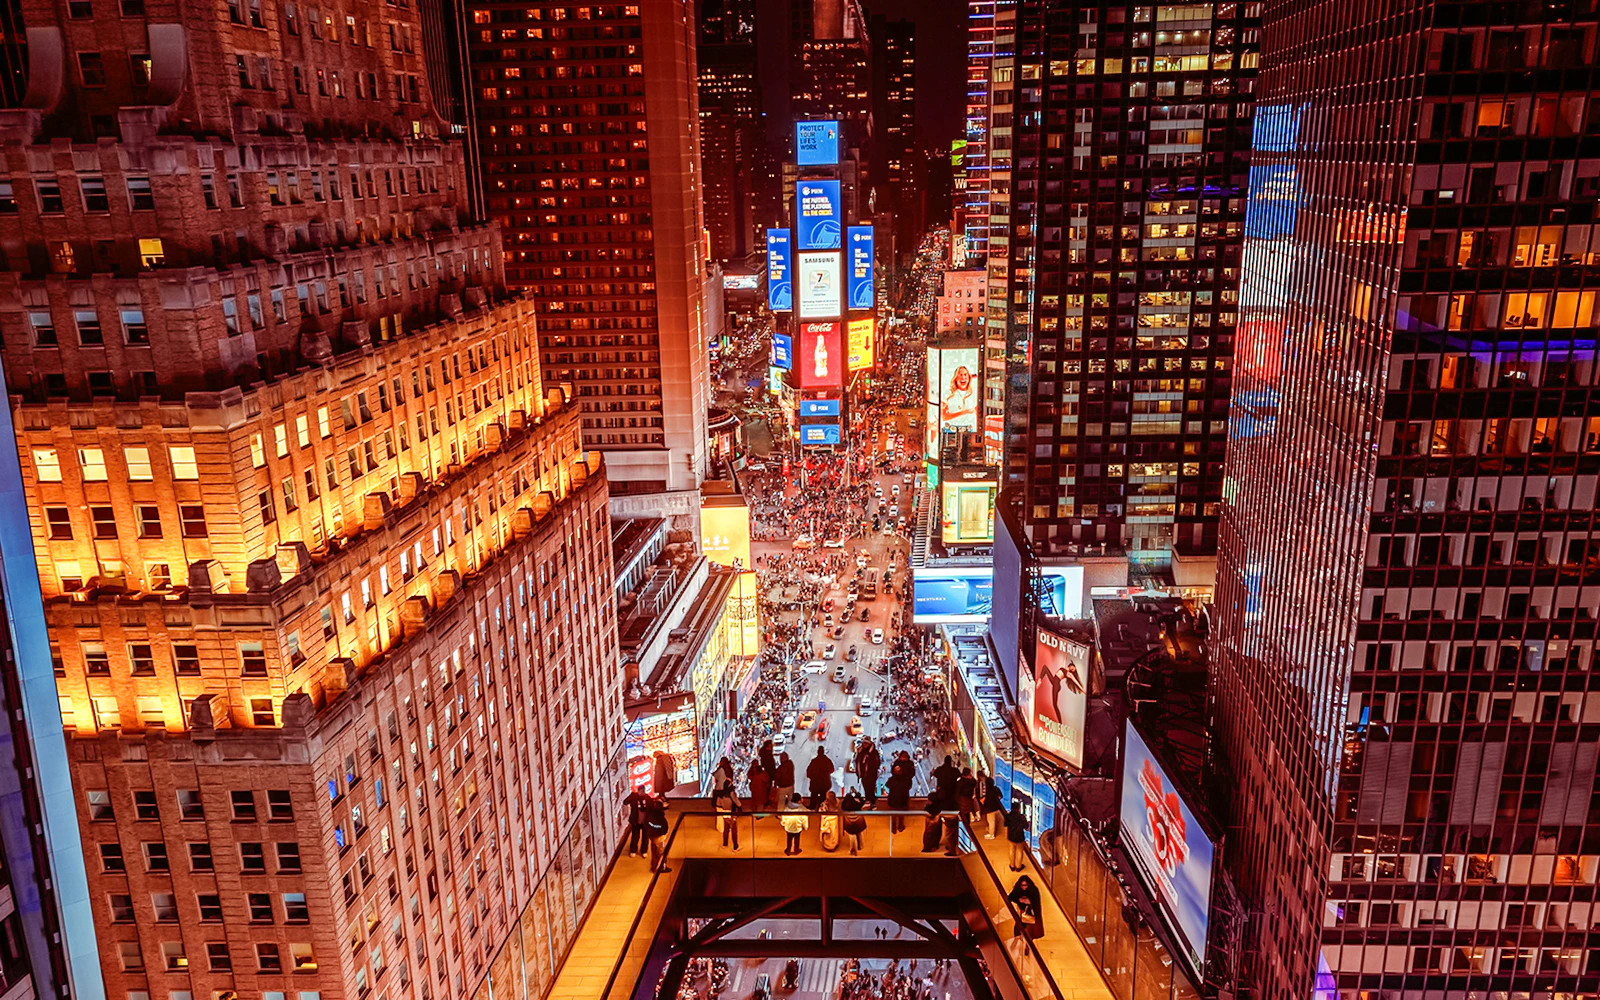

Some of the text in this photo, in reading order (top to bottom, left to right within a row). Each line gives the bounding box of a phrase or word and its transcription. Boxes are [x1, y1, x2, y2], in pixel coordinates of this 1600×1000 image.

[817, 273, 823, 283] 7
[1040, 632, 1085, 660] OLD NAVY
